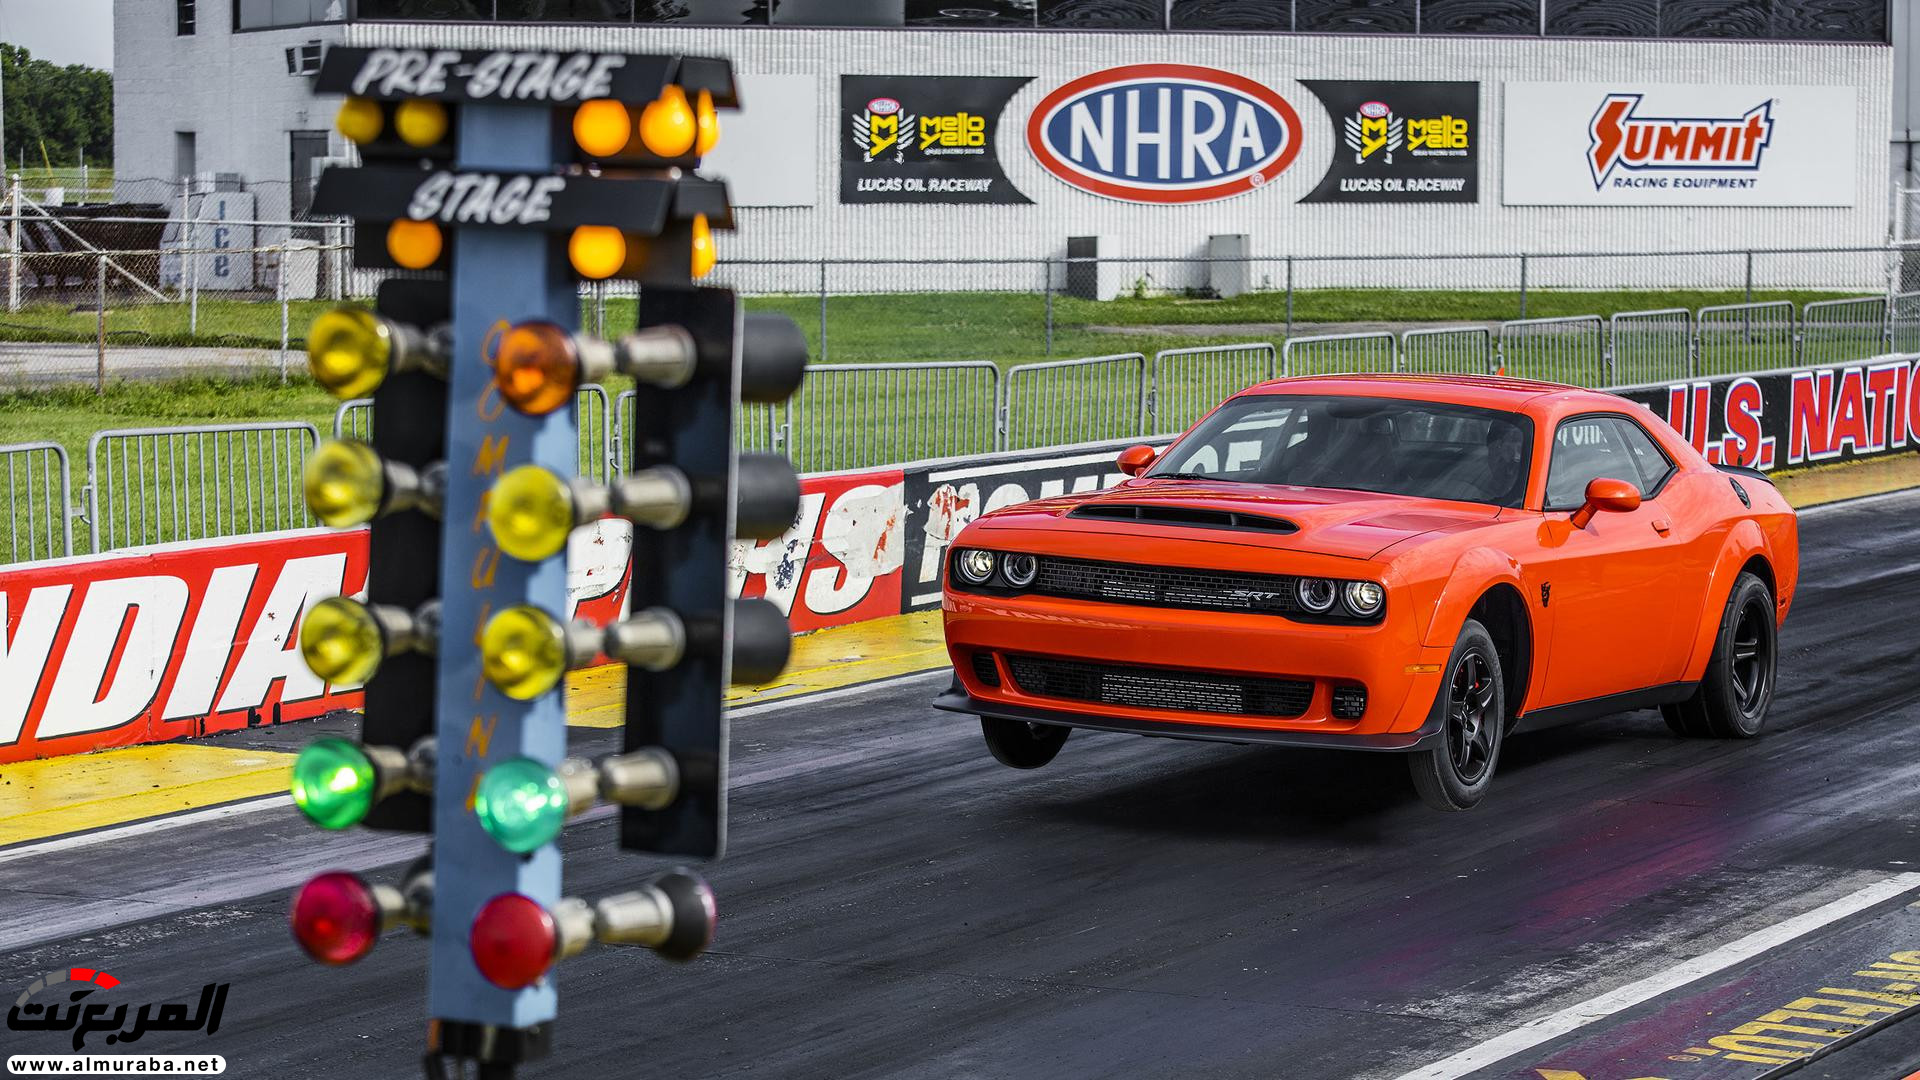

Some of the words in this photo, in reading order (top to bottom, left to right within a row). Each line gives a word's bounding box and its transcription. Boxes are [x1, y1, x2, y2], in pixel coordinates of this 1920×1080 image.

[351, 48, 627, 101] PRE-STAGE
[1071, 87, 1267, 179] NHRA
[1590, 97, 1768, 178] SUMMIT
[407, 172, 566, 224] STAGE
[857, 178, 903, 192] LUCAS
[904, 178, 928, 192] OIL
[928, 178, 993, 192] RACEWAY
[1340, 178, 1382, 192] LUCAS
[1383, 178, 1405, 192] OIL
[1406, 178, 1465, 192] RACEWAY
[1613, 177, 1668, 189] RACING
[1673, 177, 1757, 189] EQUIPMENT
[1667, 377, 1776, 471] U.S.
[1230, 590, 1280, 601] SRT
